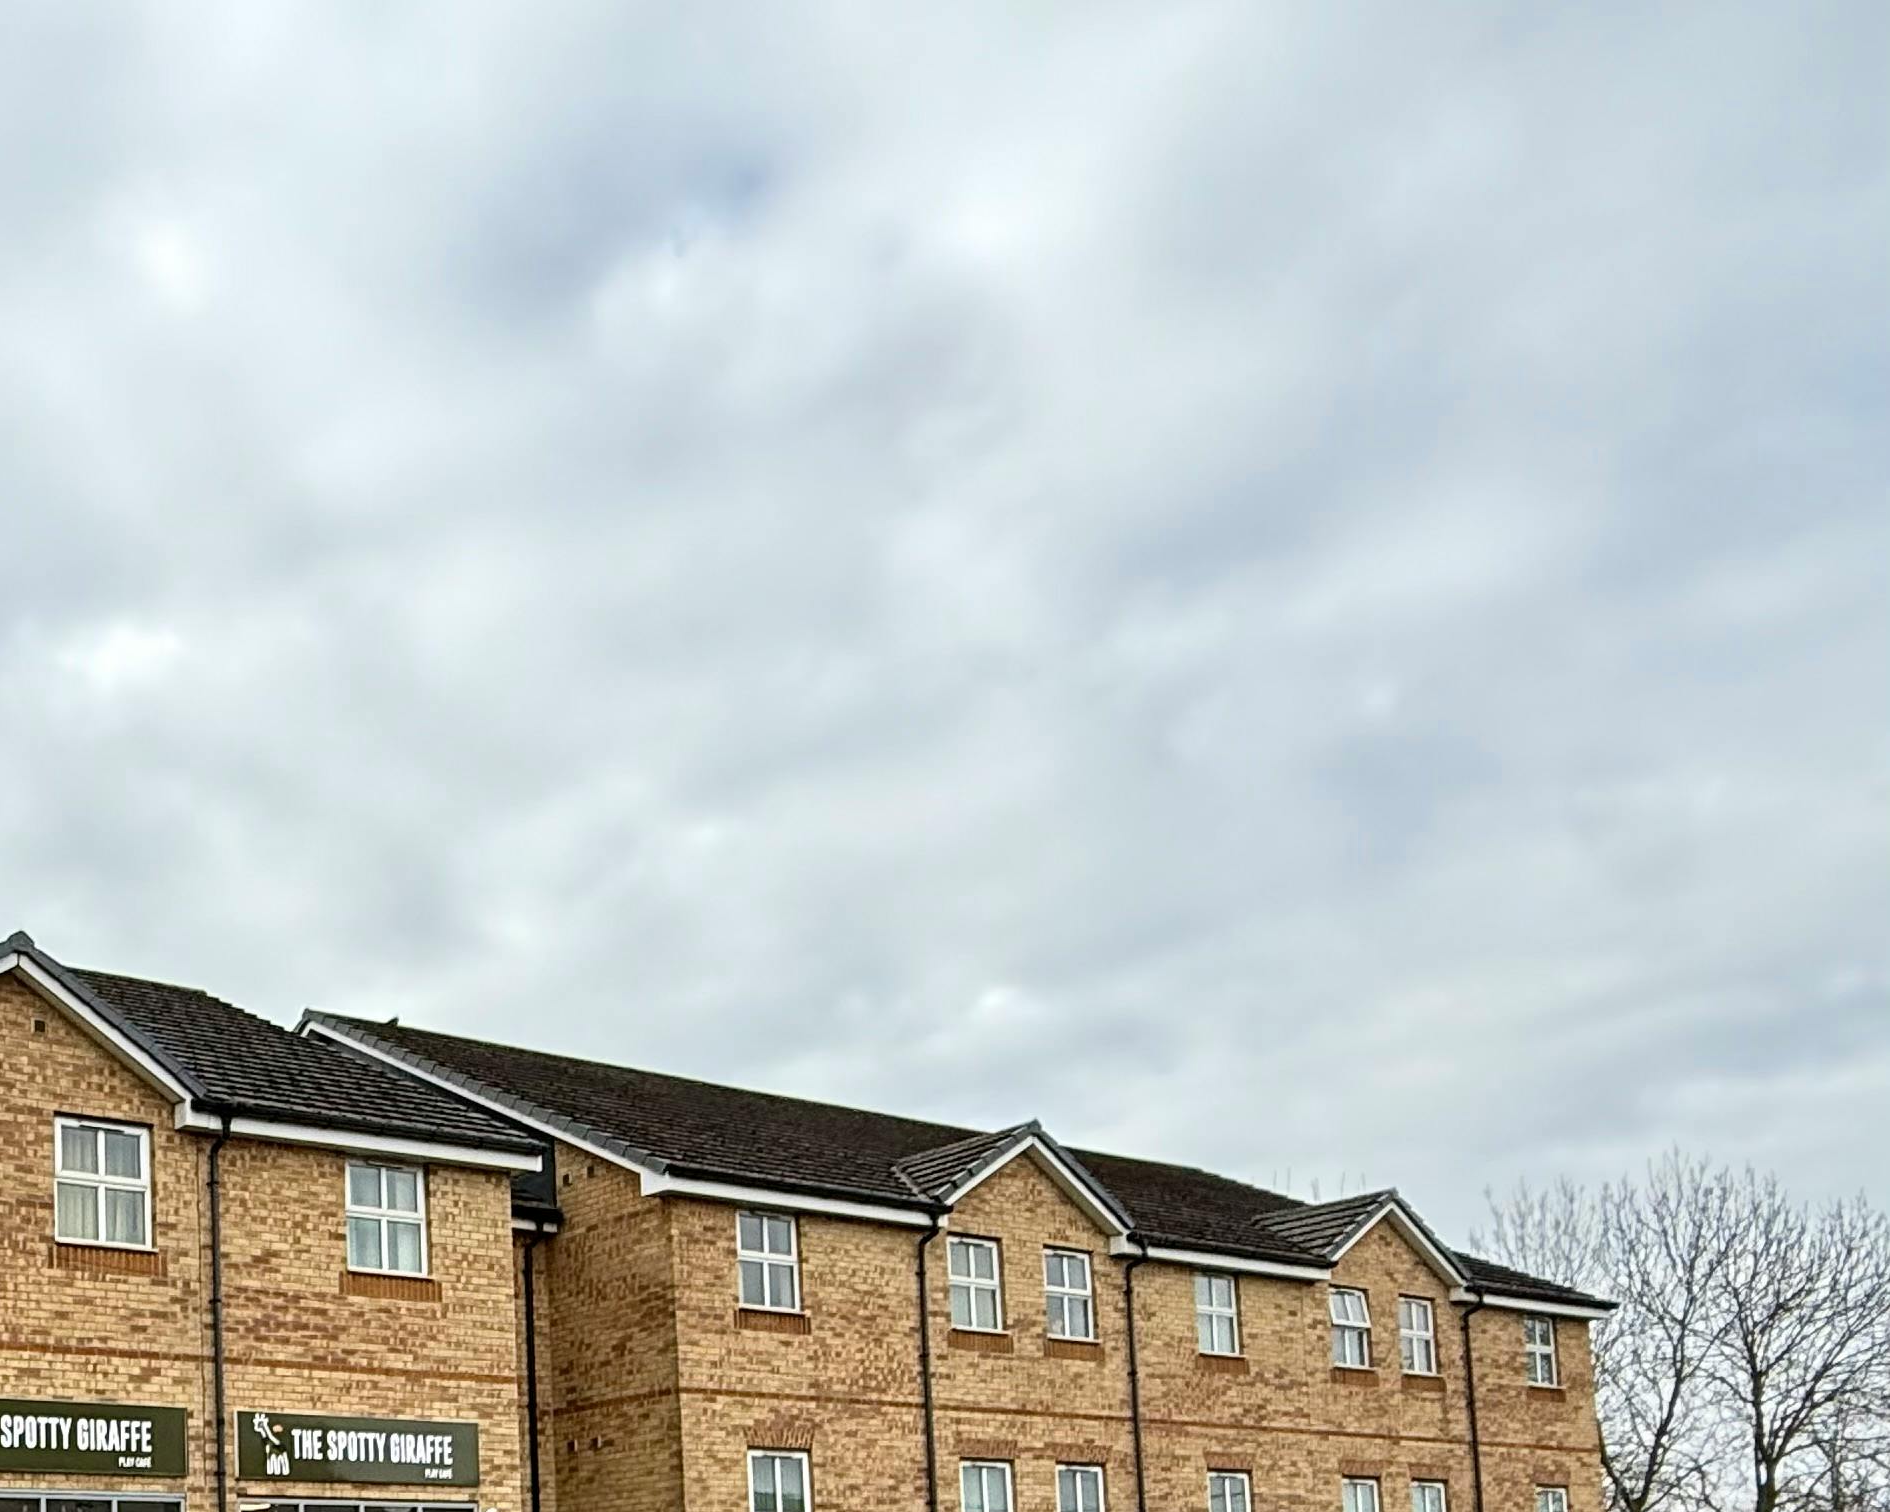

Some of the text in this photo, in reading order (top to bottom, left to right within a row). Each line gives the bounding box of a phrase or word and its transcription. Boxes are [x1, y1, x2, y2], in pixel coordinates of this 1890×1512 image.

[0, 1414, 72, 1450] SPOTTY
[76, 1418, 153, 1453] GIRAFFE
[291, 1428, 453, 1466] THE SPOTTY GIRAFFE
[118, 1456, 135, 1468] PLAY
